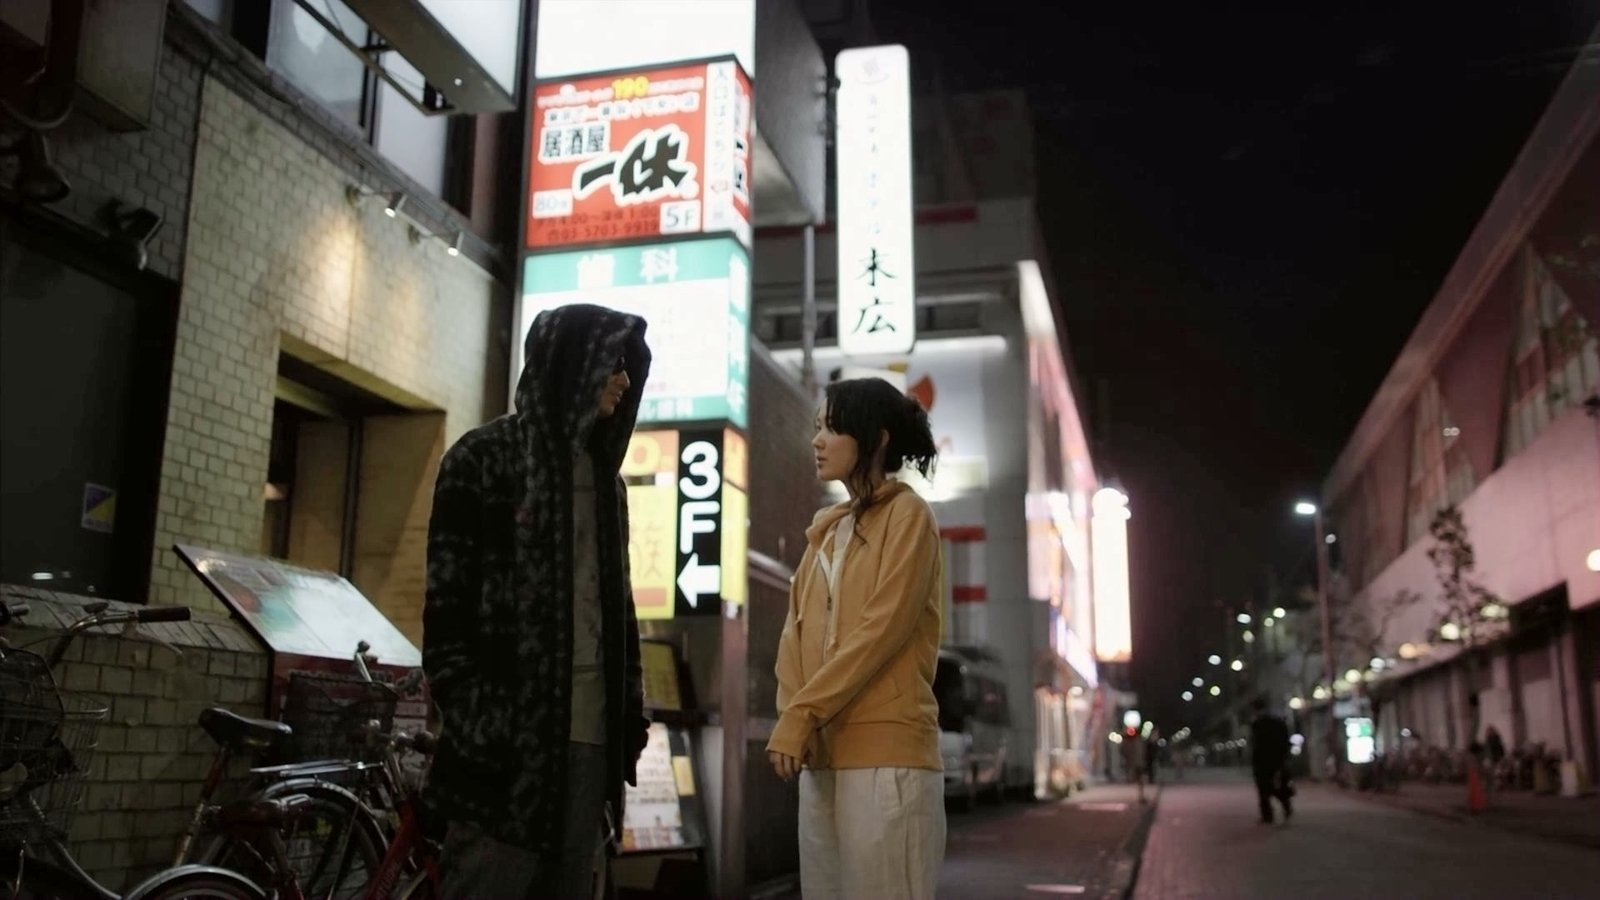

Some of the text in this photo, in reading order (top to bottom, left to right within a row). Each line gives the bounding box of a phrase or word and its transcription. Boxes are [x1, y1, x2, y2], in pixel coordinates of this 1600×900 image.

[543, 123, 606, 159] 居酒屋
[580, 131, 689, 197] 一休
[665, 205, 696, 229] 5F
[679, 440, 720, 554] 3F
